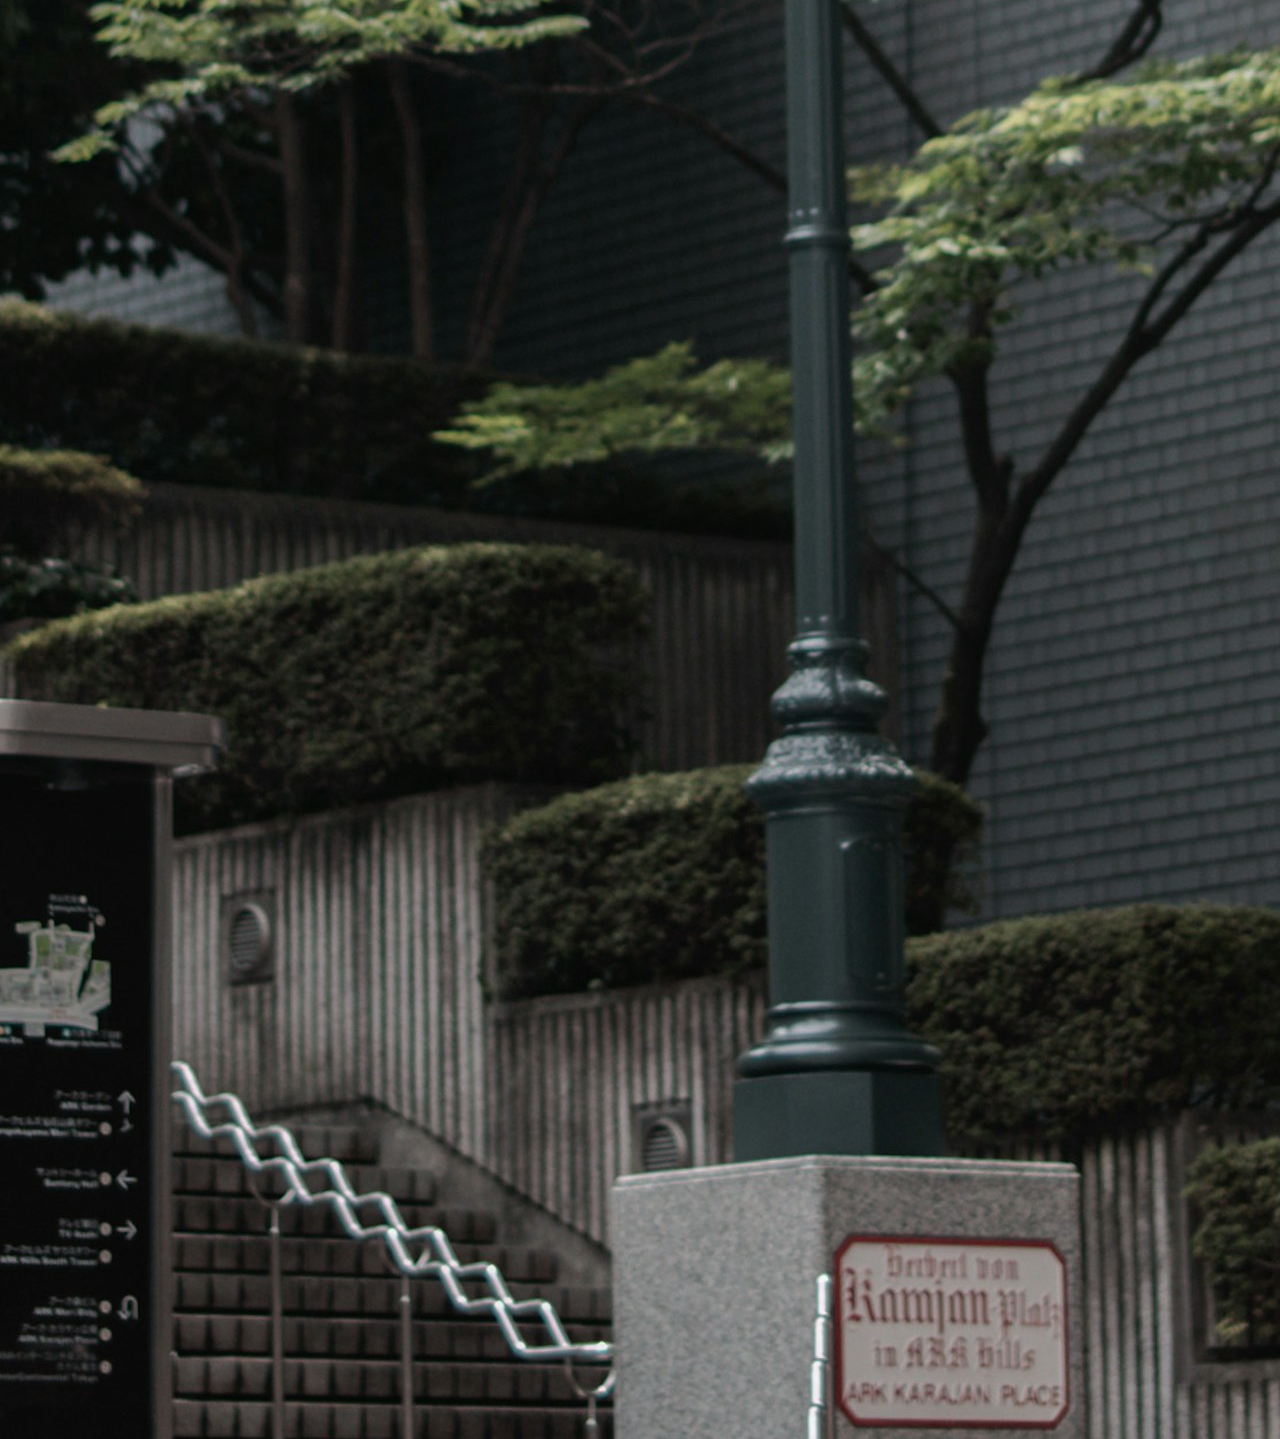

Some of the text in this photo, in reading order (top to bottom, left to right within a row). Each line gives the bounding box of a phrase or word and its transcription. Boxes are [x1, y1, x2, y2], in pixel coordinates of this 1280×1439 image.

[976, 1257, 1020, 1280] von
[842, 1266, 990, 1334] Karajan
[873, 1338, 898, 1368] in
[976, 1335, 1037, 1371] Hills
[846, 1382, 1061, 1408] ARK KARAJAN PLACE
